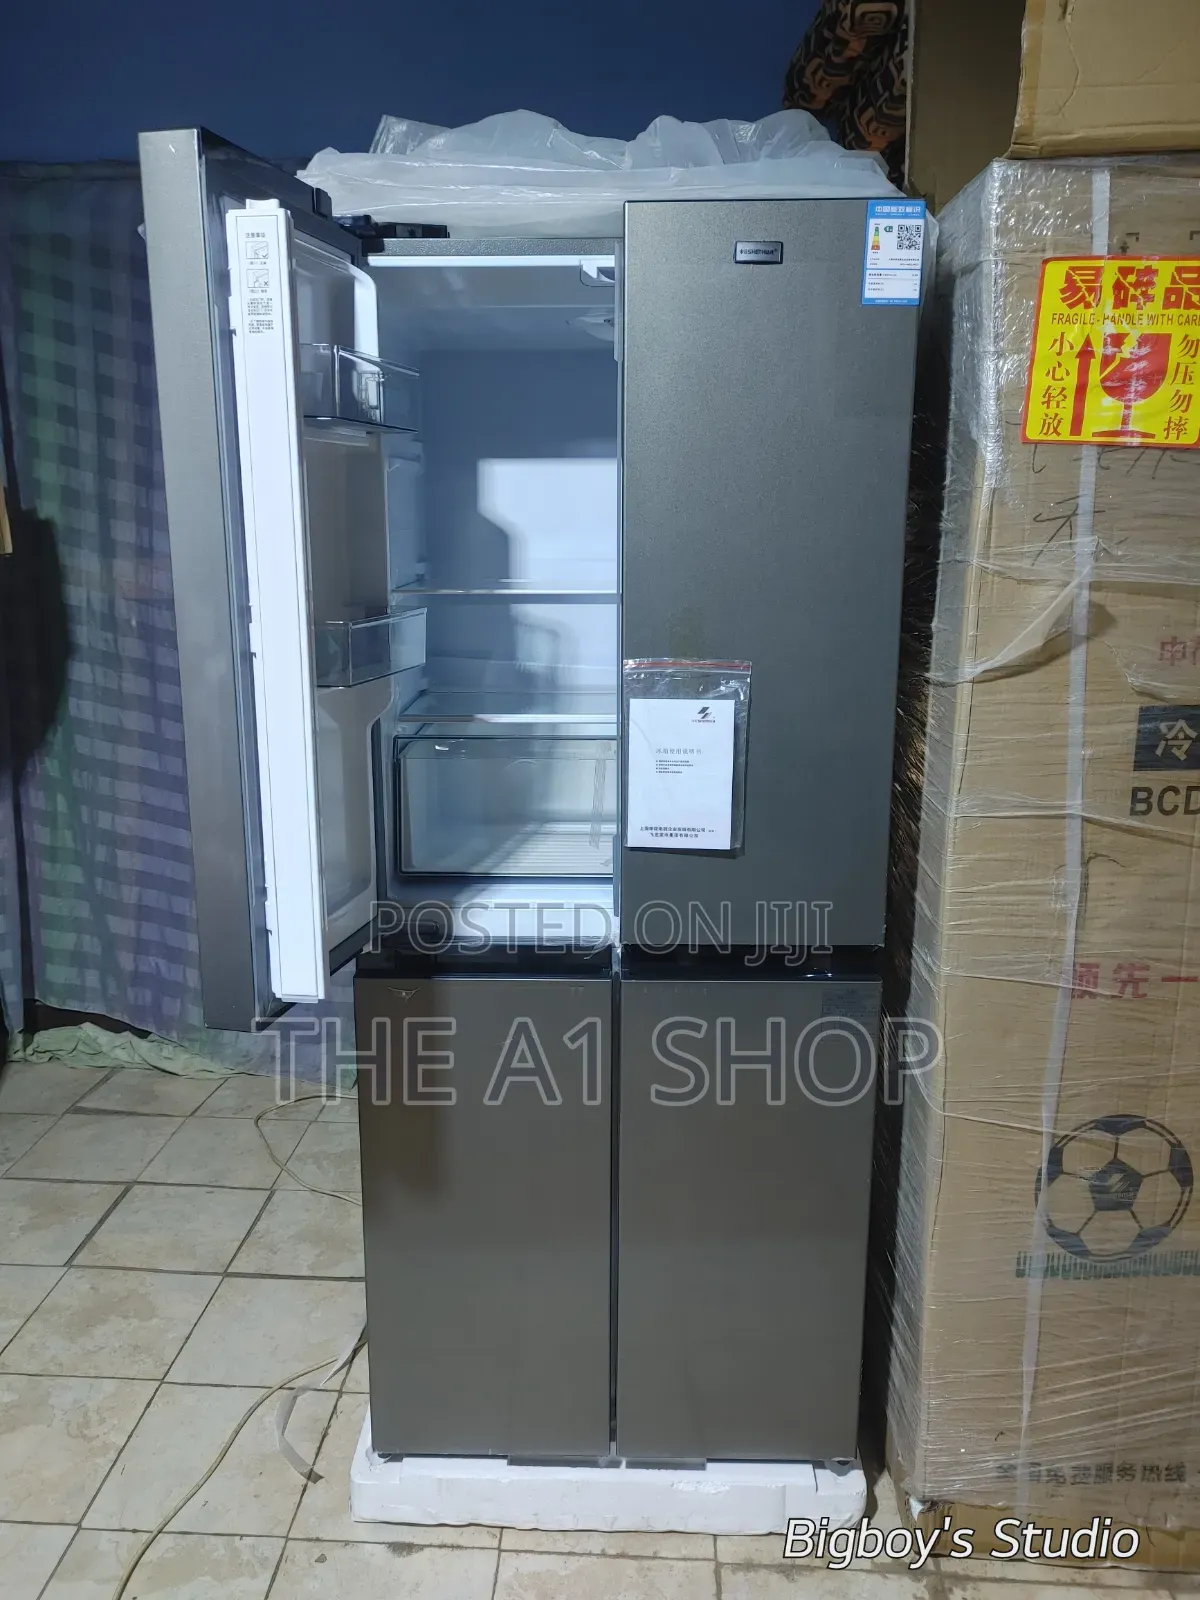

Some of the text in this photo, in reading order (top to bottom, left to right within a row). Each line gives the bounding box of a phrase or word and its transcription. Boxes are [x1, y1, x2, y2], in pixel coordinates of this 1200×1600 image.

[1059, 264, 1200, 311] 易碎品
[1147, 313, 1173, 326] WITH
[1038, 331, 1075, 438] 小心轻放
[1163, 333, 1200, 441] 勿压勿摔
[1155, 718, 1198, 762] 冷
